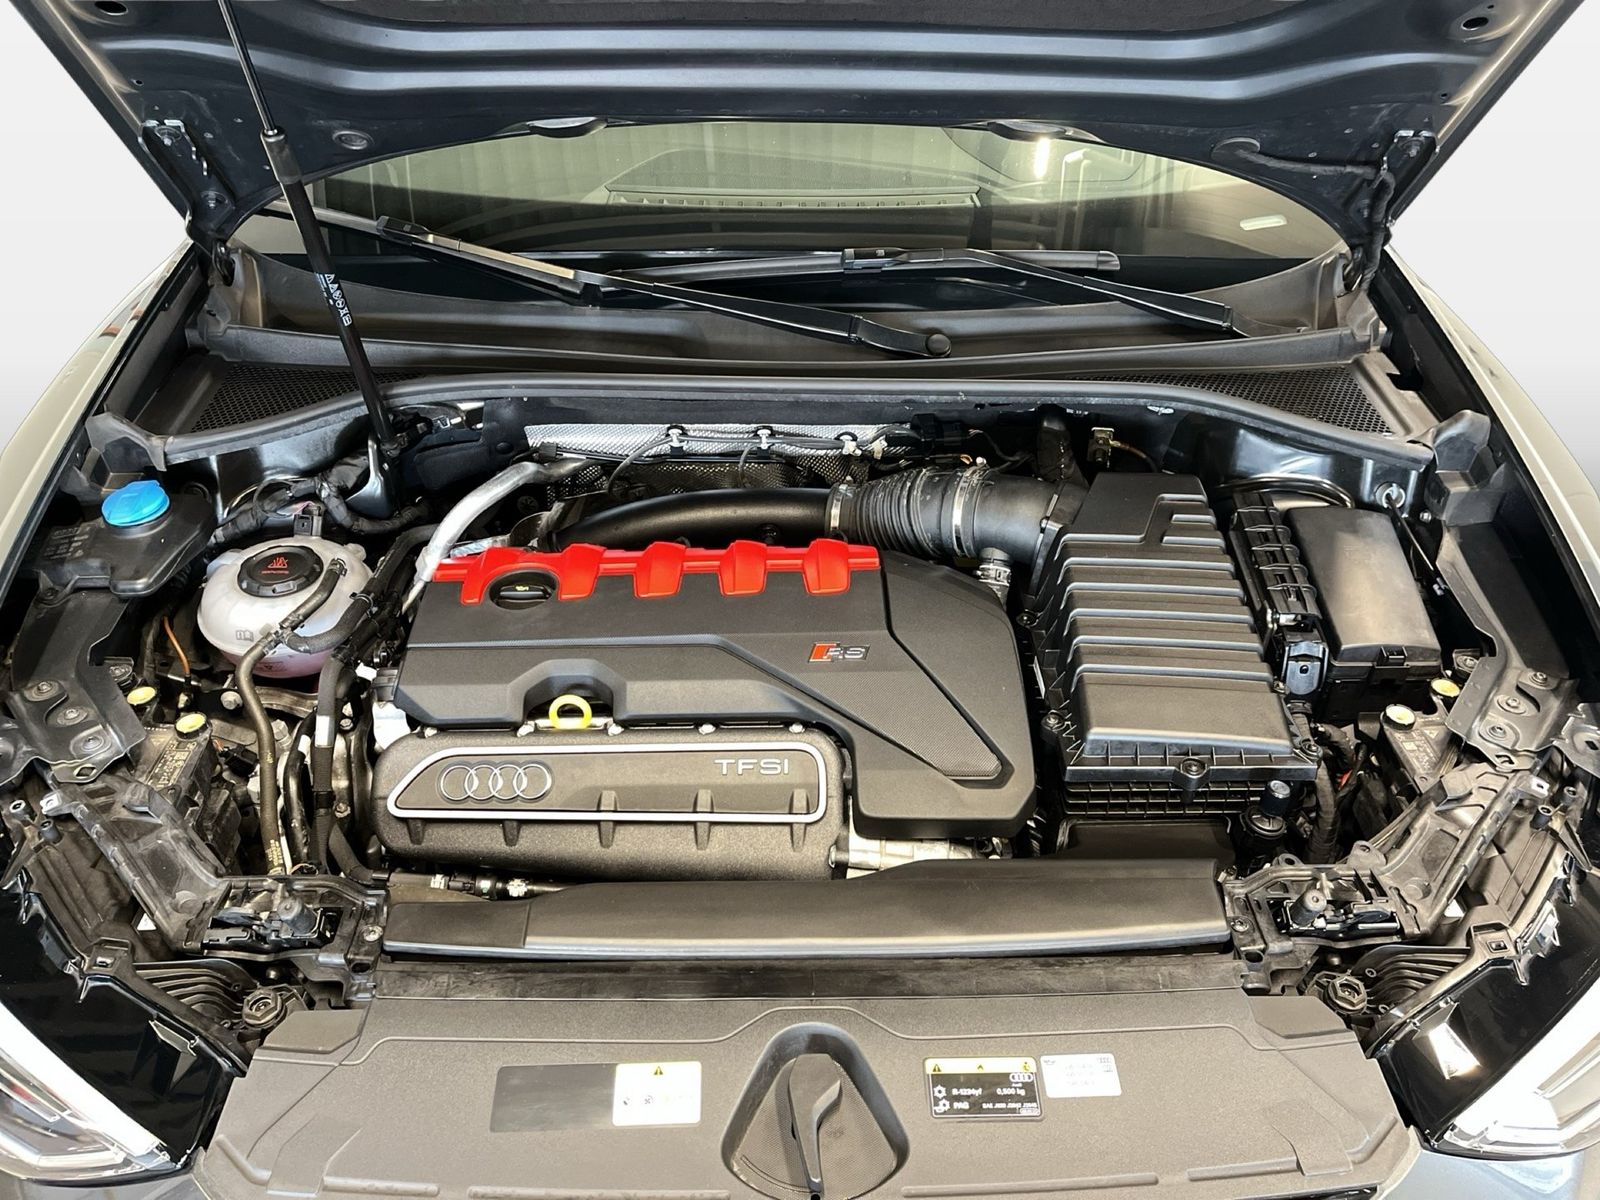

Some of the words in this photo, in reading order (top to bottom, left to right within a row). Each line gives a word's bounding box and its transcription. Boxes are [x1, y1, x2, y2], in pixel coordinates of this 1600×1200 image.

[821, 646, 867, 660] RS
[714, 758, 789, 775] TFSI
[1016, 1088, 1026, 1097] kg
